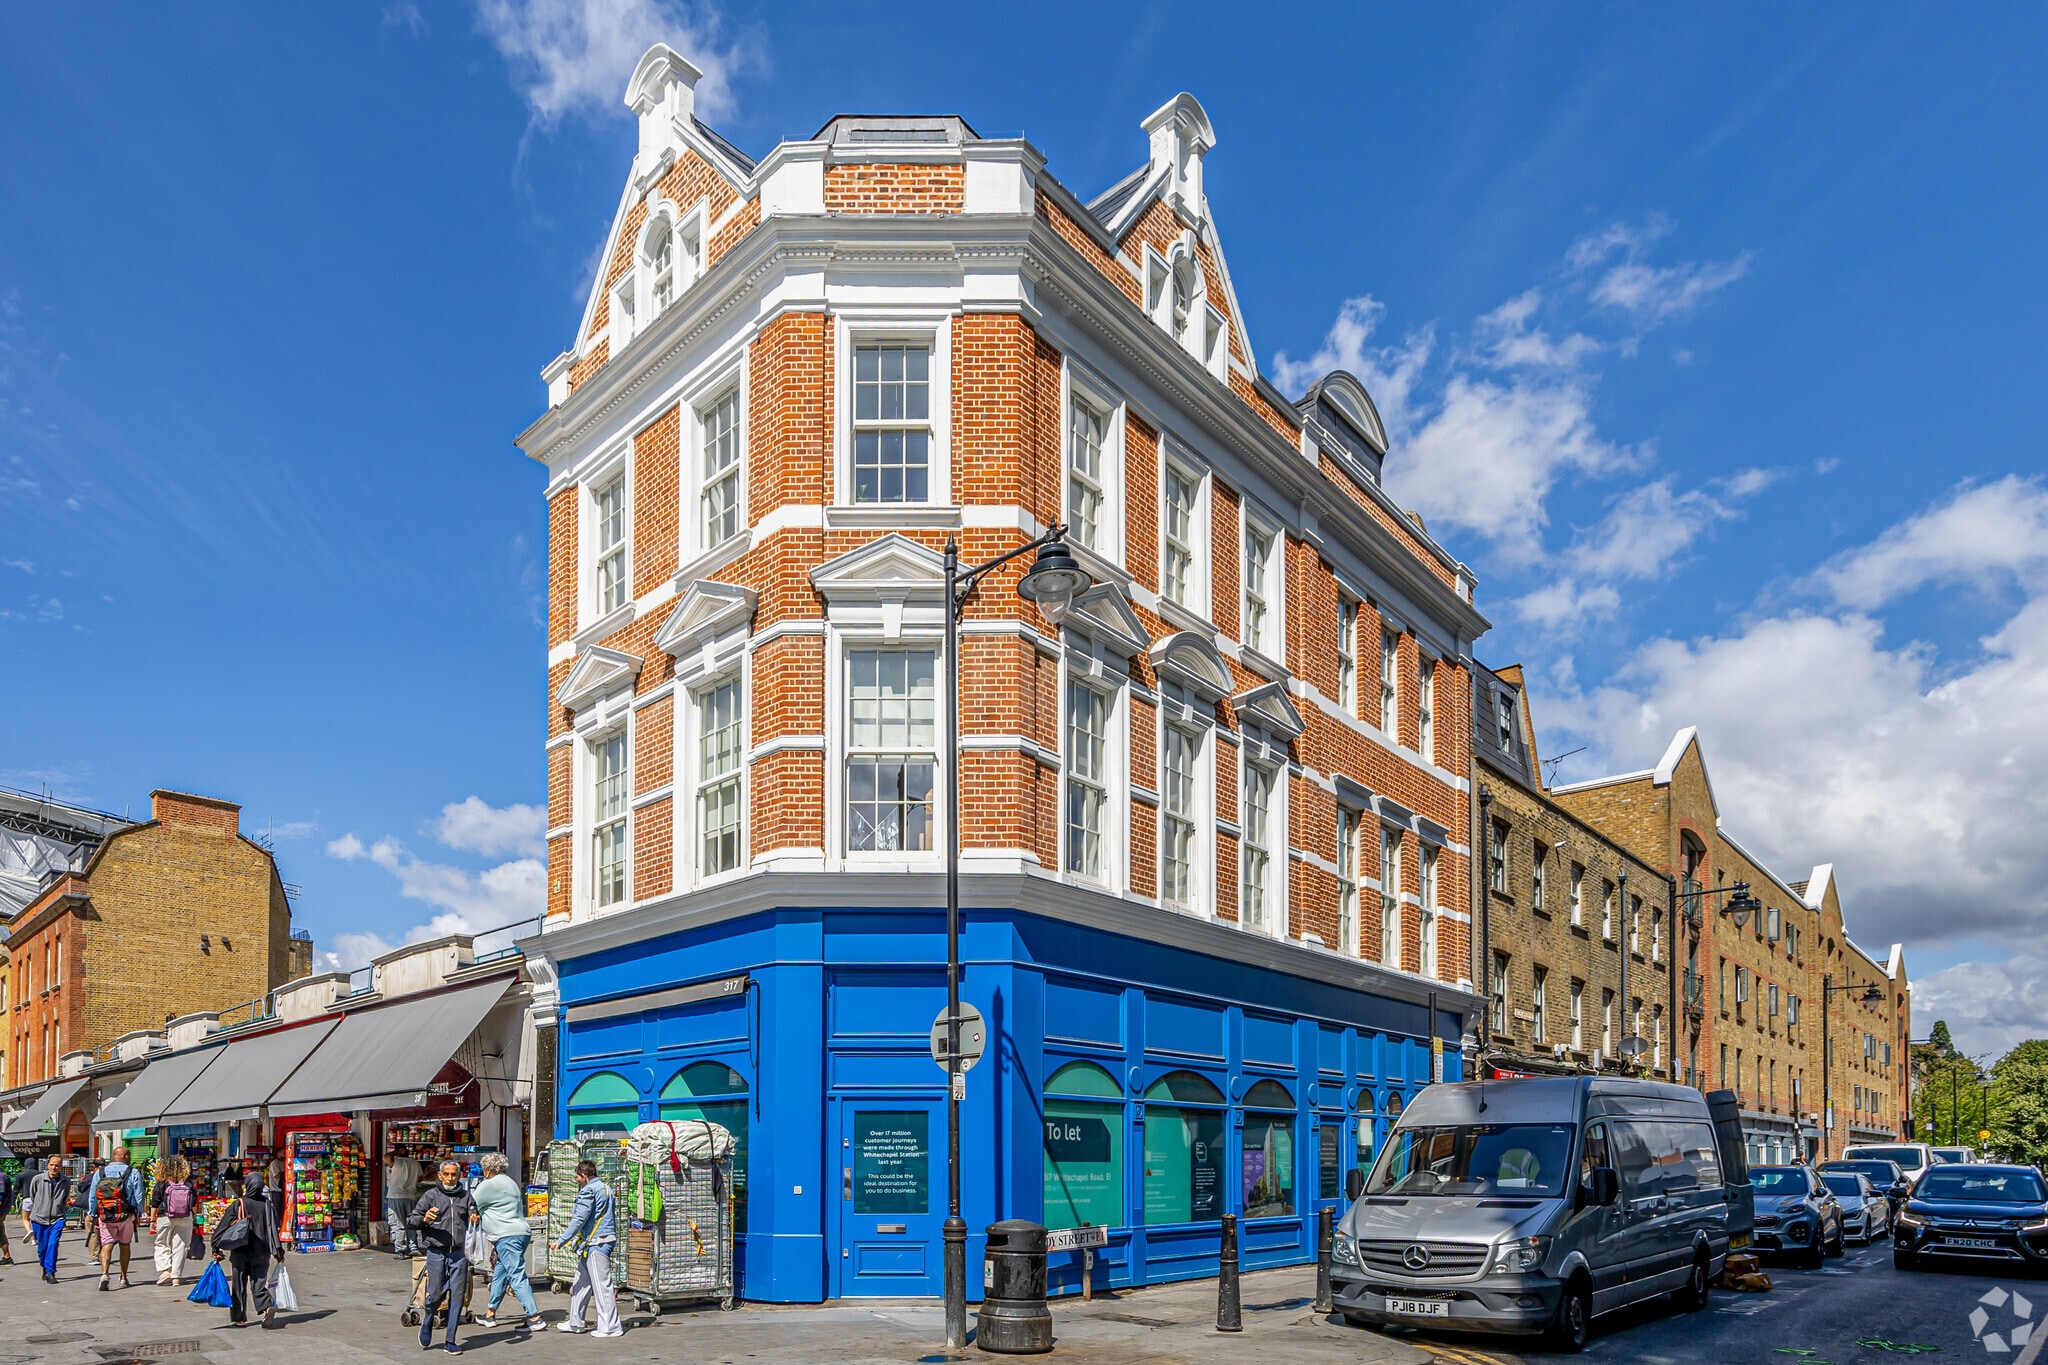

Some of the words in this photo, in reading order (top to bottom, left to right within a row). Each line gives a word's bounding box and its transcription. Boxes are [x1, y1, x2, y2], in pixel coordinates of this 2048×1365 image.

[724, 980, 739, 992] 317
[1046, 1122, 1061, 1140] To
[1065, 1123, 1081, 1141] let
[13, 1147, 40, 1155] coffee
[1046, 1236, 1057, 1247] DY
[1058, 1231, 1090, 1246] STREET
[1095, 1231, 1104, 1242] E1
[1947, 1238, 1972, 1246] FN20
[1974, 1239, 1993, 1247] CHC
[1392, 1300, 1416, 1313] PJ18
[1418, 1303, 1441, 1314] DJF
